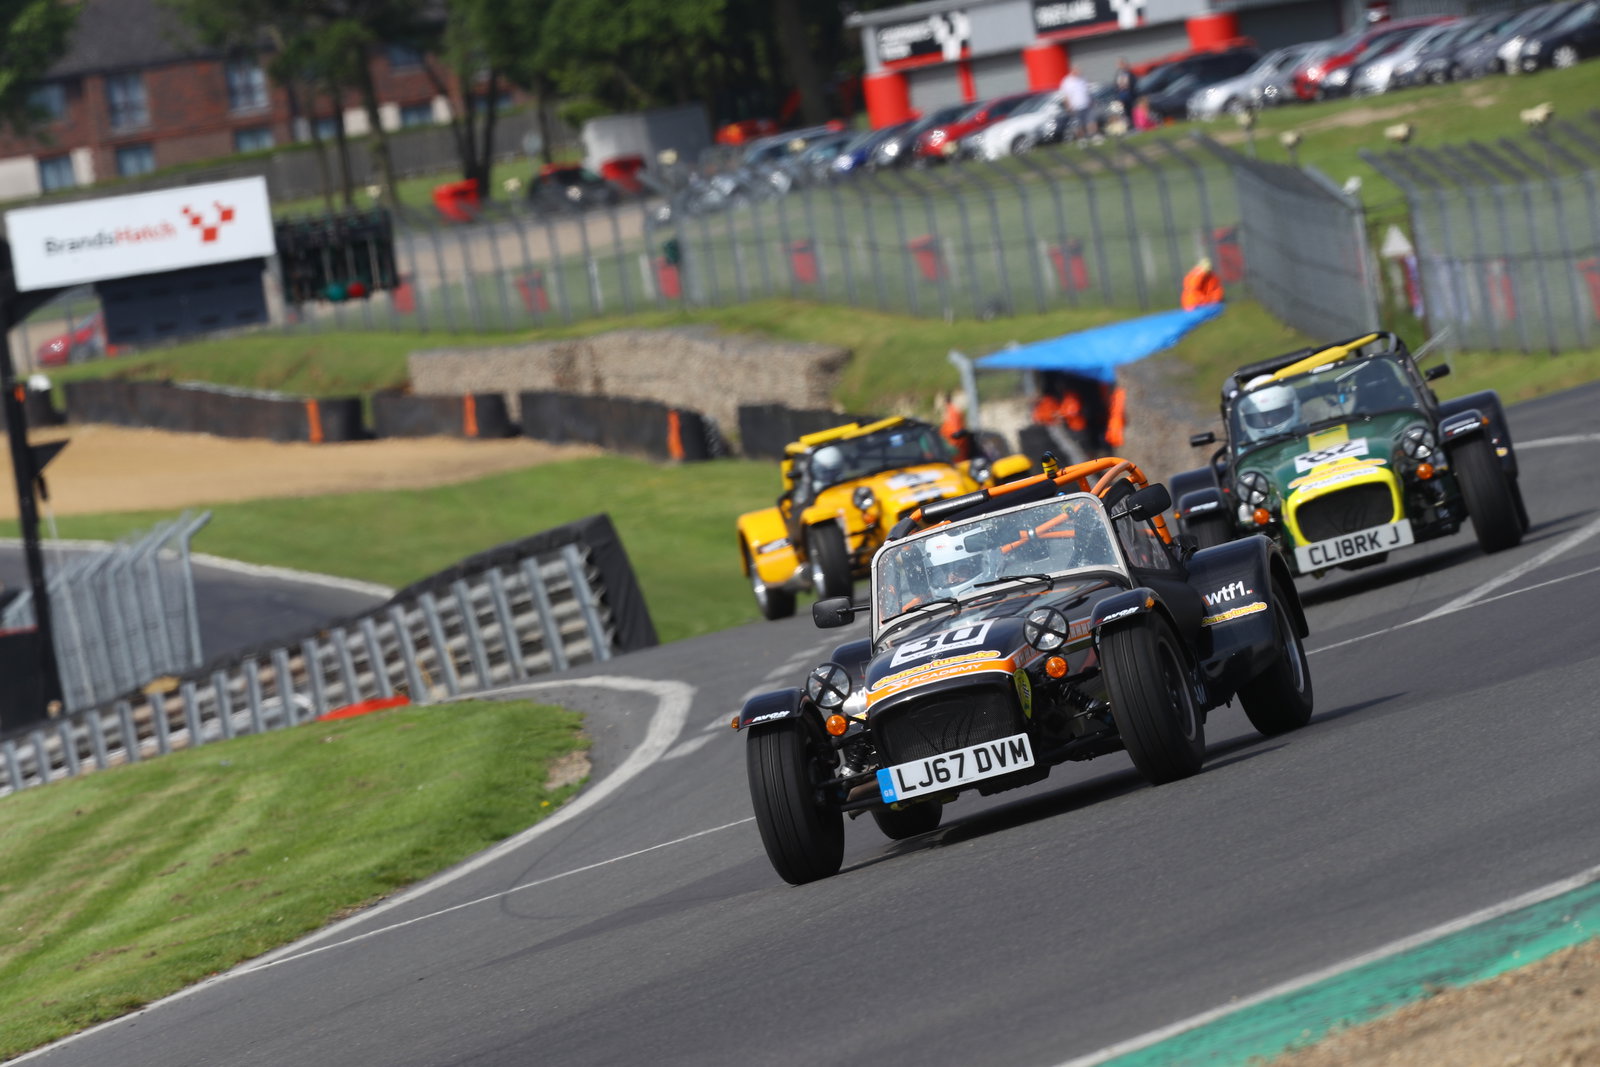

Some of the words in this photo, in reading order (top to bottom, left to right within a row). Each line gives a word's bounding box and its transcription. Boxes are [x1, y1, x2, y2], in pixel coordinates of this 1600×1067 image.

[1389, 526, 1400, 545] J
[901, 622, 987, 658] 30
[906, 662, 983, 685] ACADEMY
[896, 752, 965, 793] LJ67
[972, 737, 1029, 774] DVM
